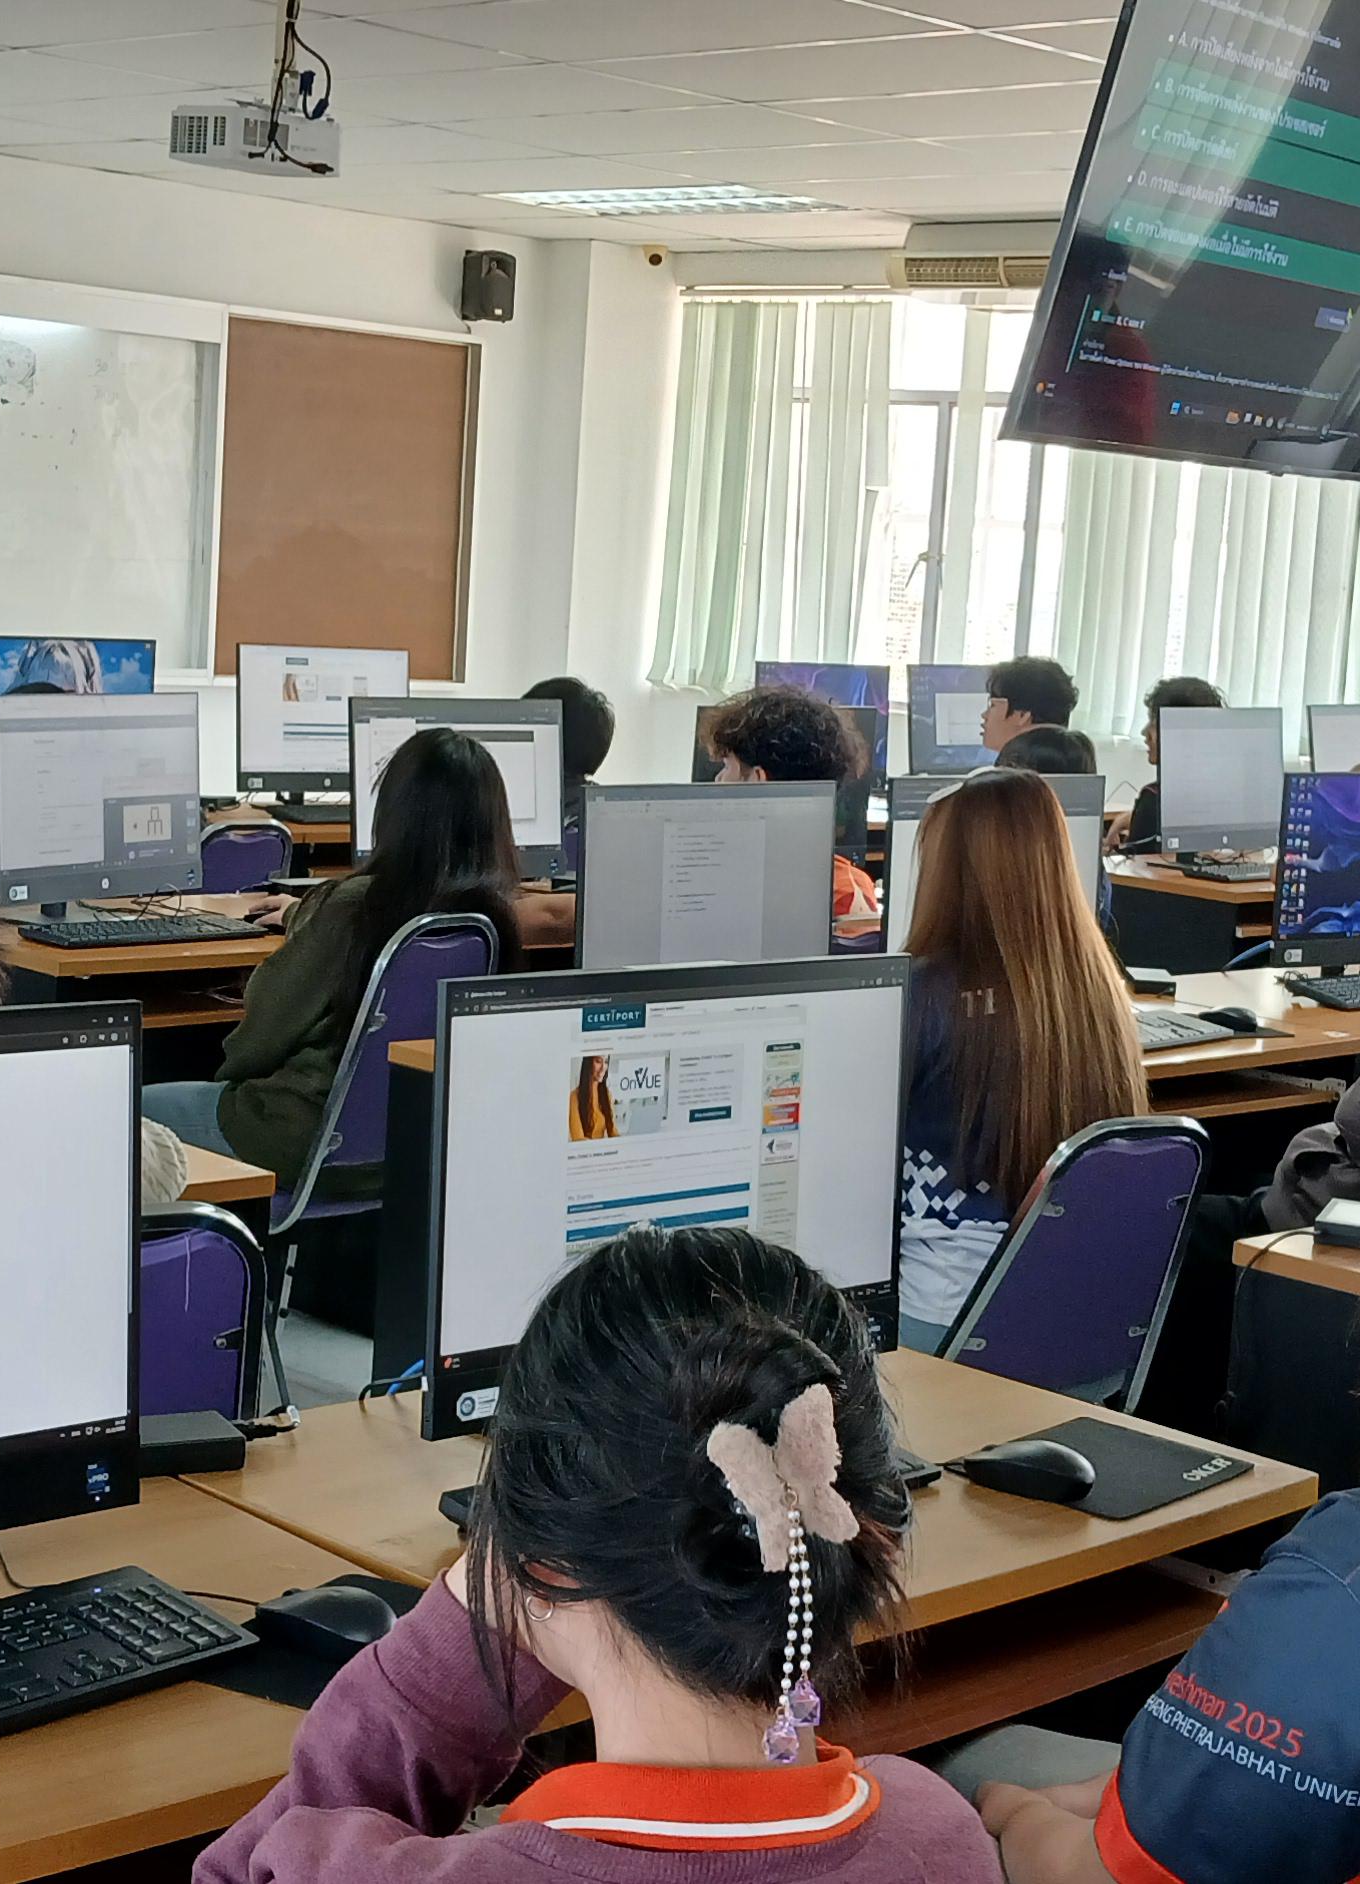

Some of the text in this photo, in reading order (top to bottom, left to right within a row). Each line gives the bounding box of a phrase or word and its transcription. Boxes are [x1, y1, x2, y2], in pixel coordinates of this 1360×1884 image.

[587, 1008, 641, 1023] CERTIPORT
[619, 1067, 662, 1089] OnVUE
[1182, 1455, 1233, 1481] OKER
[1225, 1701, 1306, 1758] 2025
